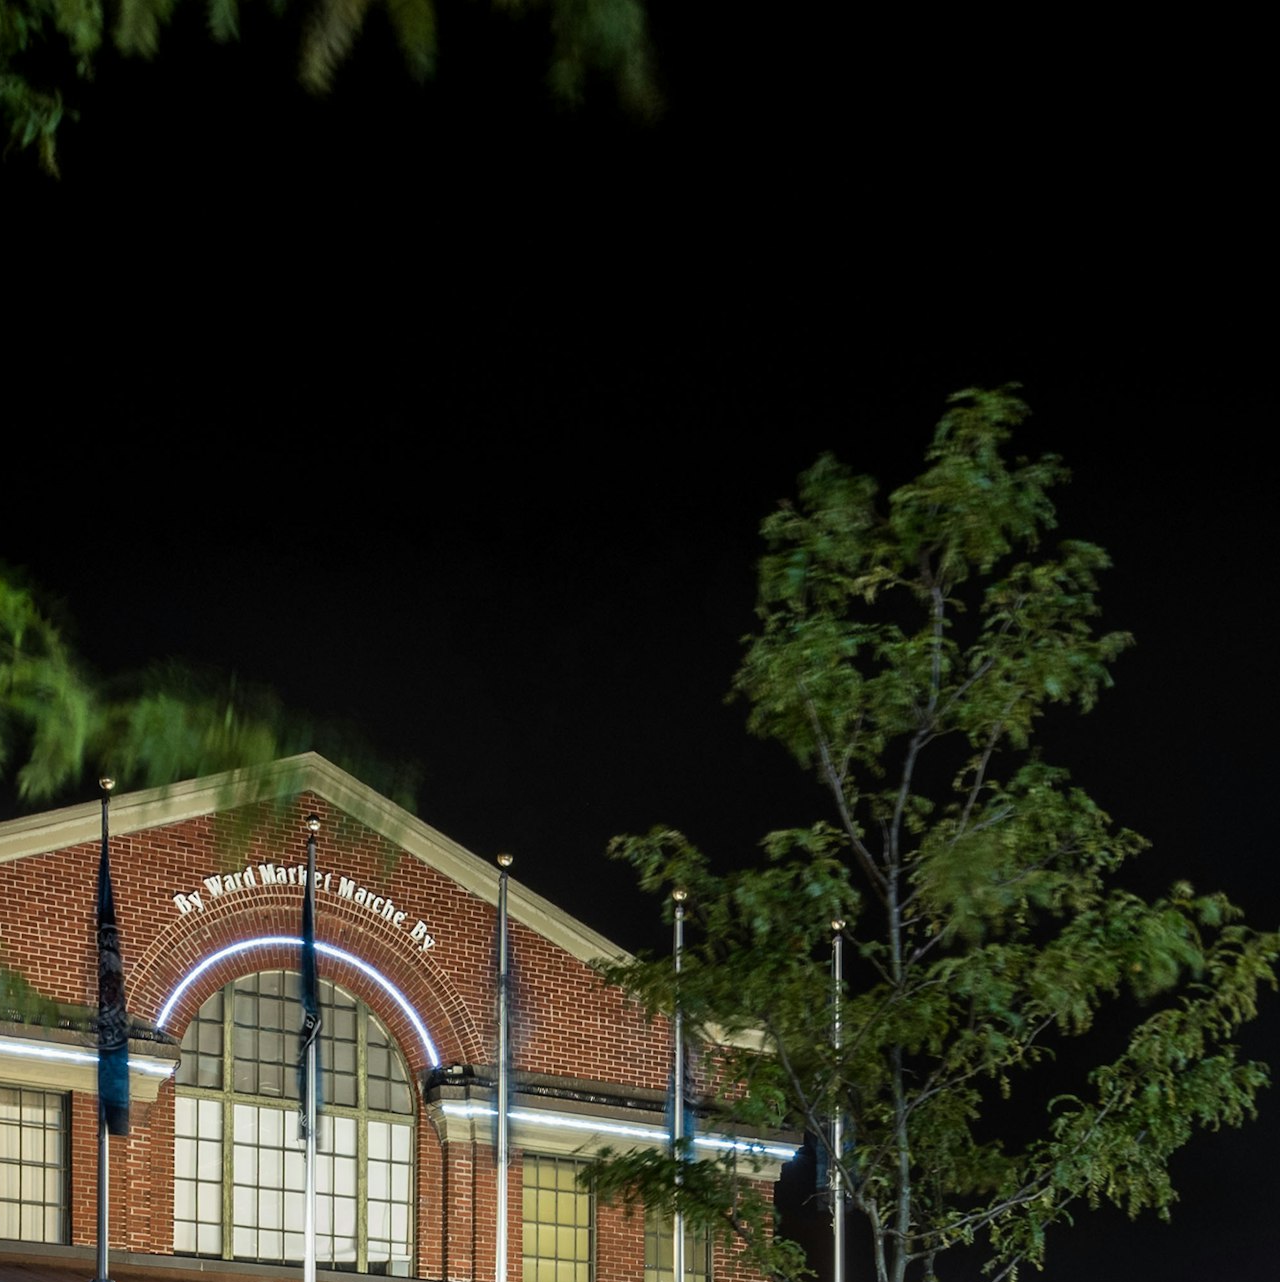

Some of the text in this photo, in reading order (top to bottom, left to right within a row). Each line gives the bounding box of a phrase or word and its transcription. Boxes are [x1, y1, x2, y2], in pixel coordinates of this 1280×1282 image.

[173, 890, 204, 915] By
[203, 866, 257, 897] Ward
[258, 863, 332, 894] Market
[410, 919, 436, 952] By
